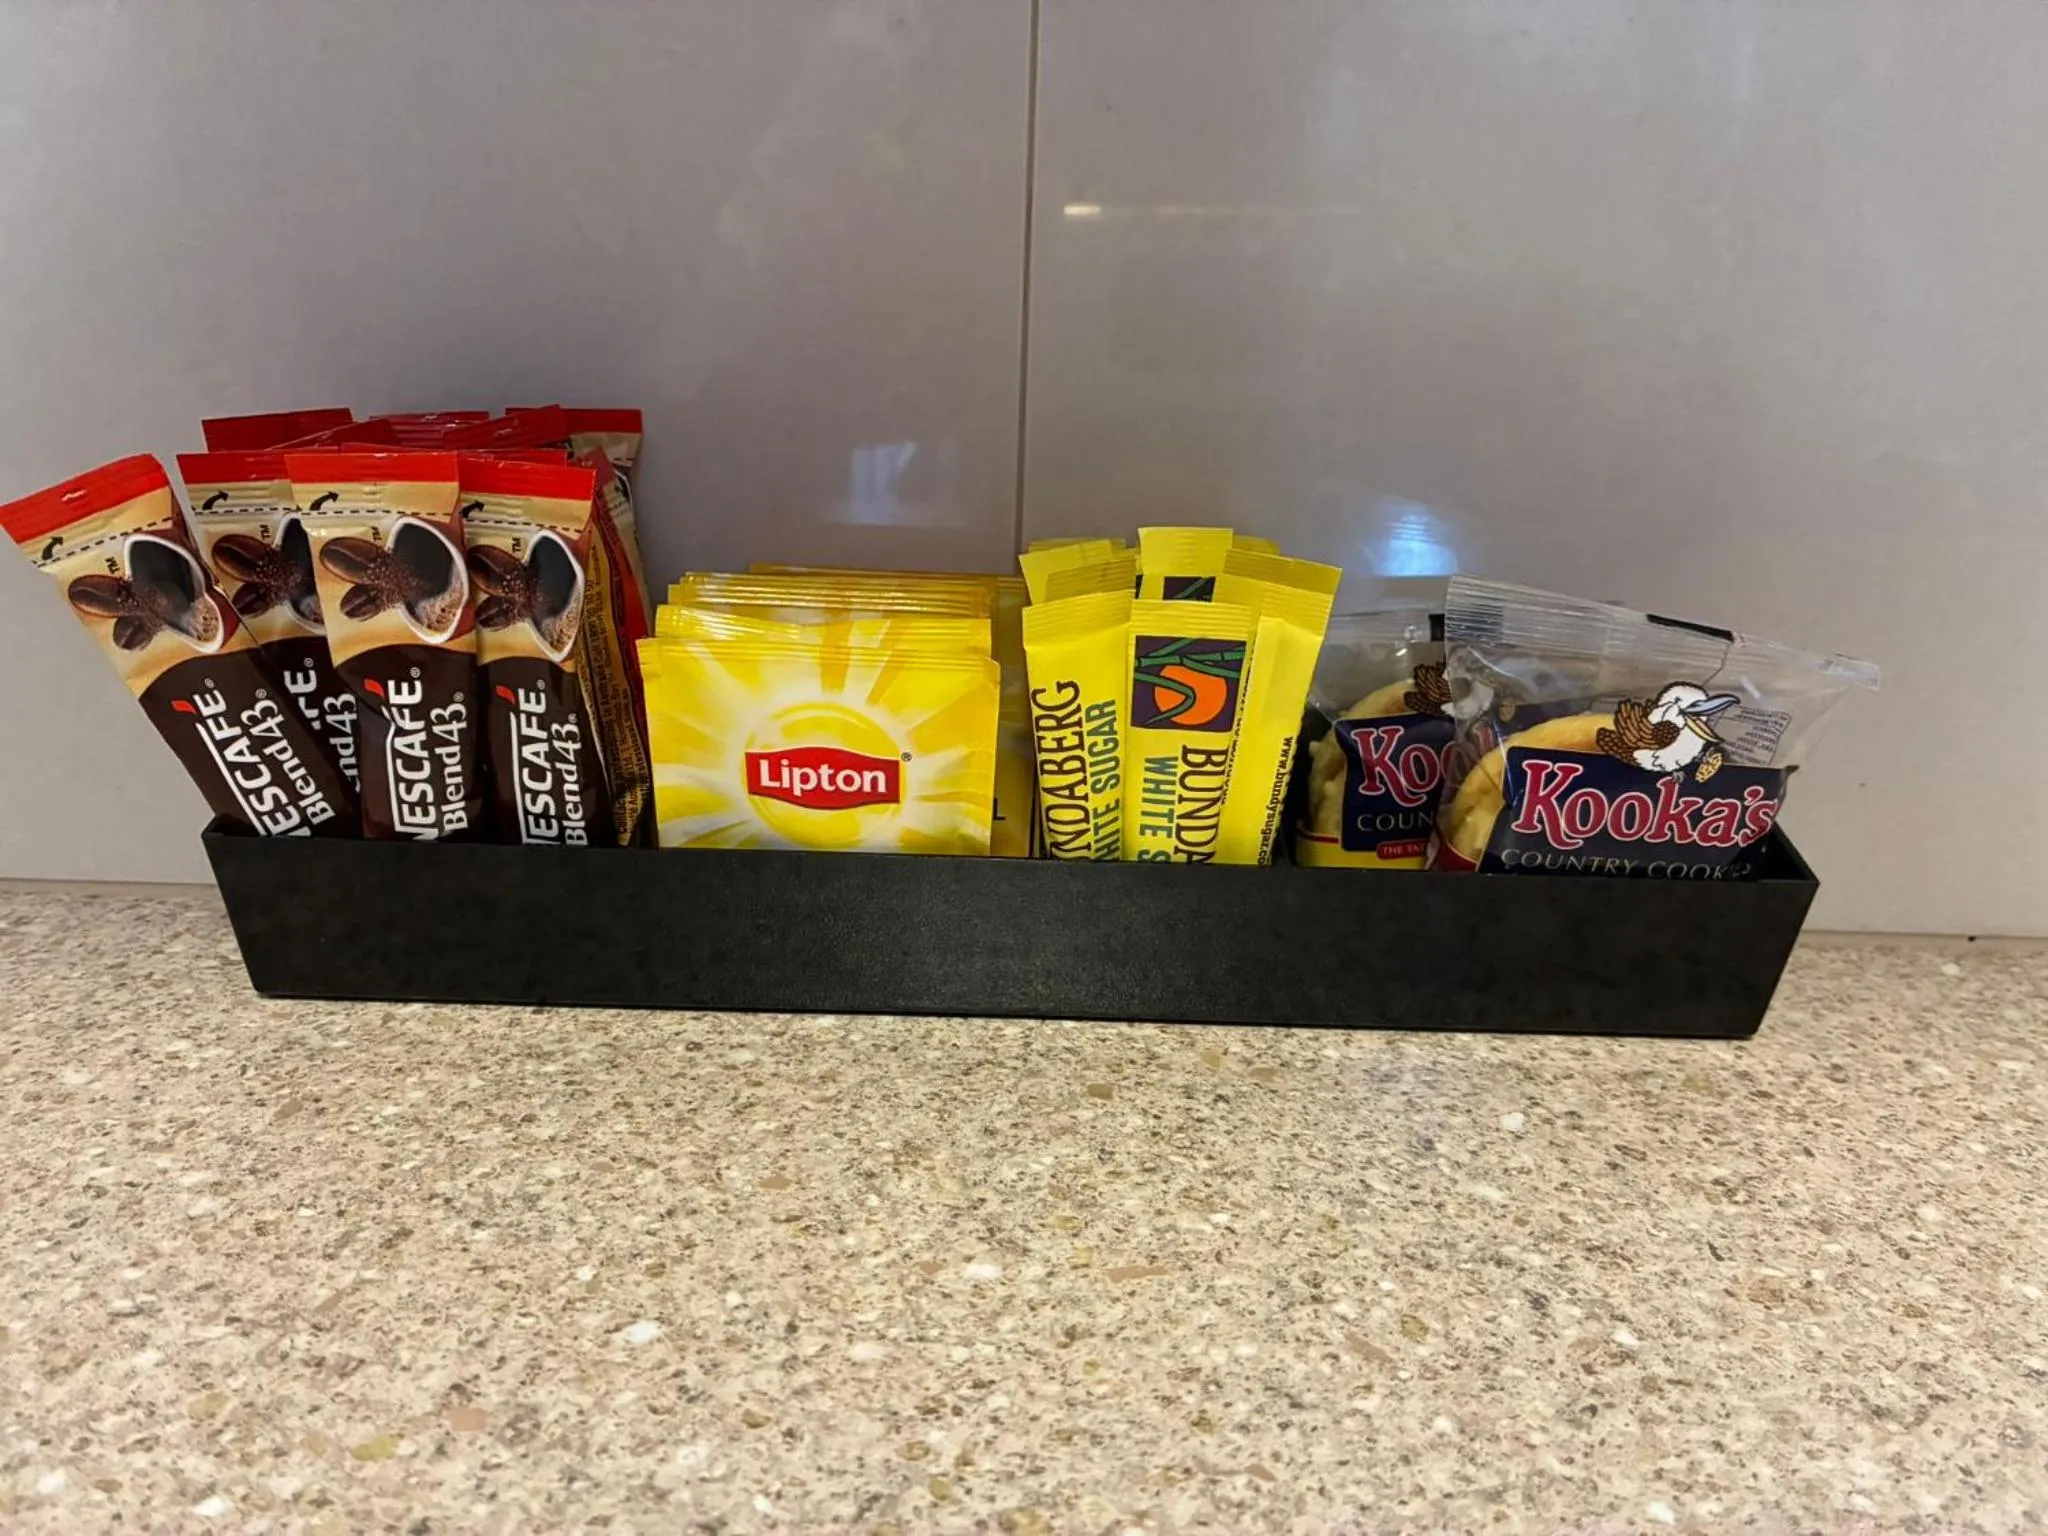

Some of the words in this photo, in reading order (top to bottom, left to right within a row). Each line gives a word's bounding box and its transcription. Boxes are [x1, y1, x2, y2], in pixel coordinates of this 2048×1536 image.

[171, 690, 311, 836] ESCAFÉ
[496, 686, 560, 844] ESCAFÉ
[759, 759, 886, 796] Lipton
[1031, 680, 1091, 859] NDABERG
[1085, 700, 1120, 794] SUGAR
[1139, 755, 1178, 838] WHITE
[1511, 759, 1777, 849] Kooka's
[1501, 849, 1638, 874] COUNTRY
